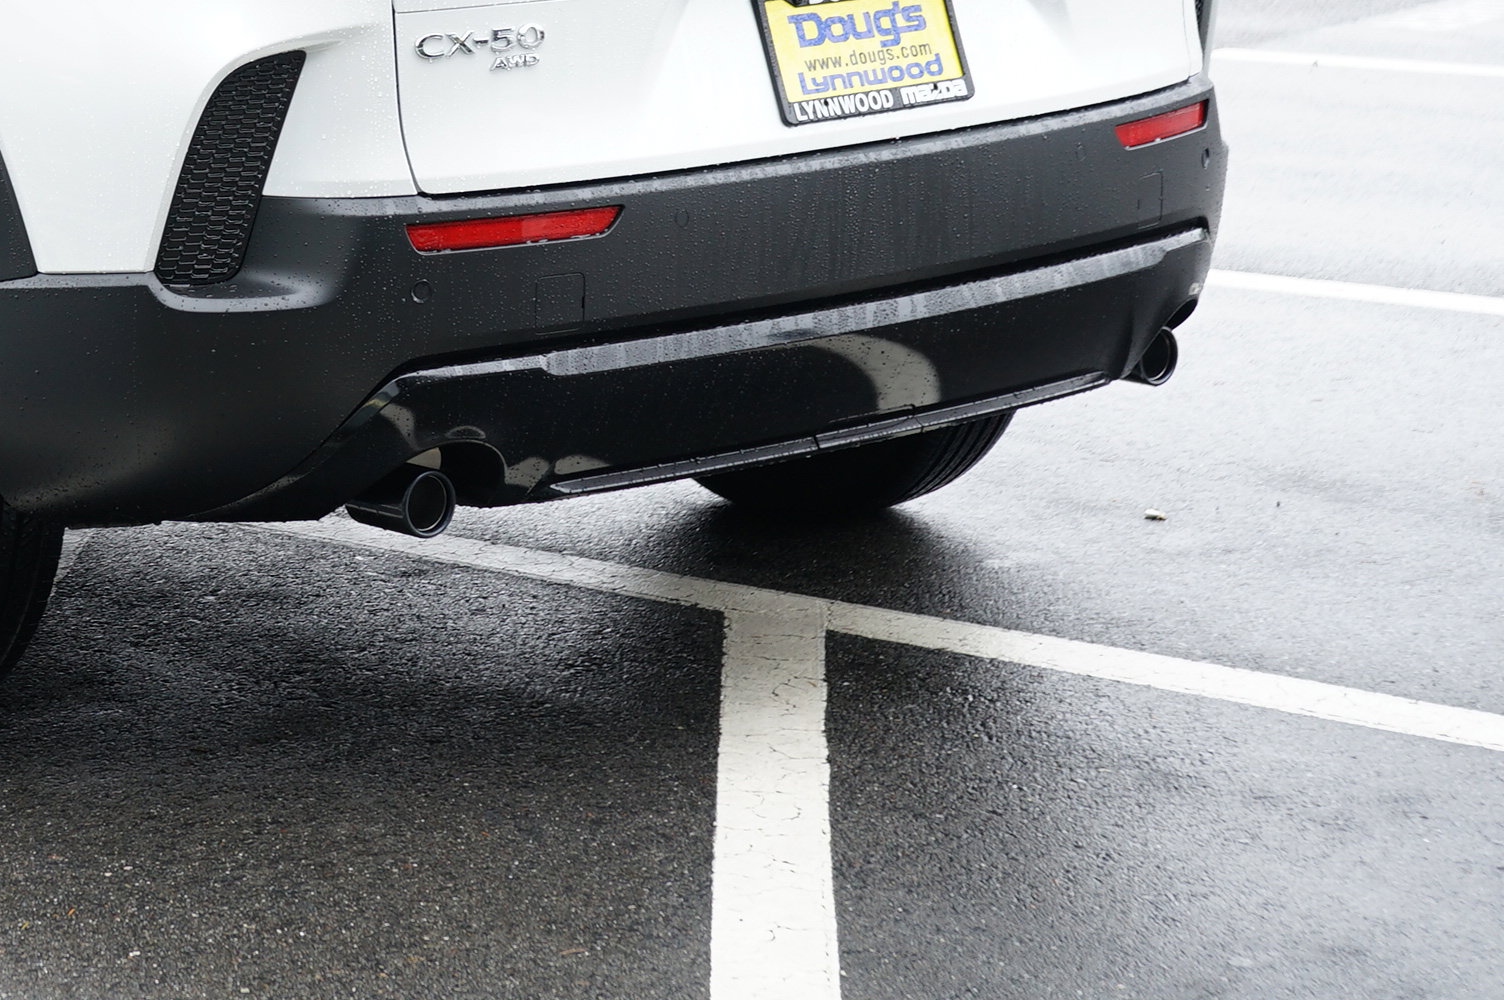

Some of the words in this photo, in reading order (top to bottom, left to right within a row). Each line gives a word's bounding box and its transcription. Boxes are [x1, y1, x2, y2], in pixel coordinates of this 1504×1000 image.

[414, 23, 545, 59] CX-50
[804, 41, 933, 73] www.dougs.com
[489, 52, 540, 71] AWD
[797, 53, 944, 96] Lynnwood
[793, 88, 894, 122] LYNNWOOD
